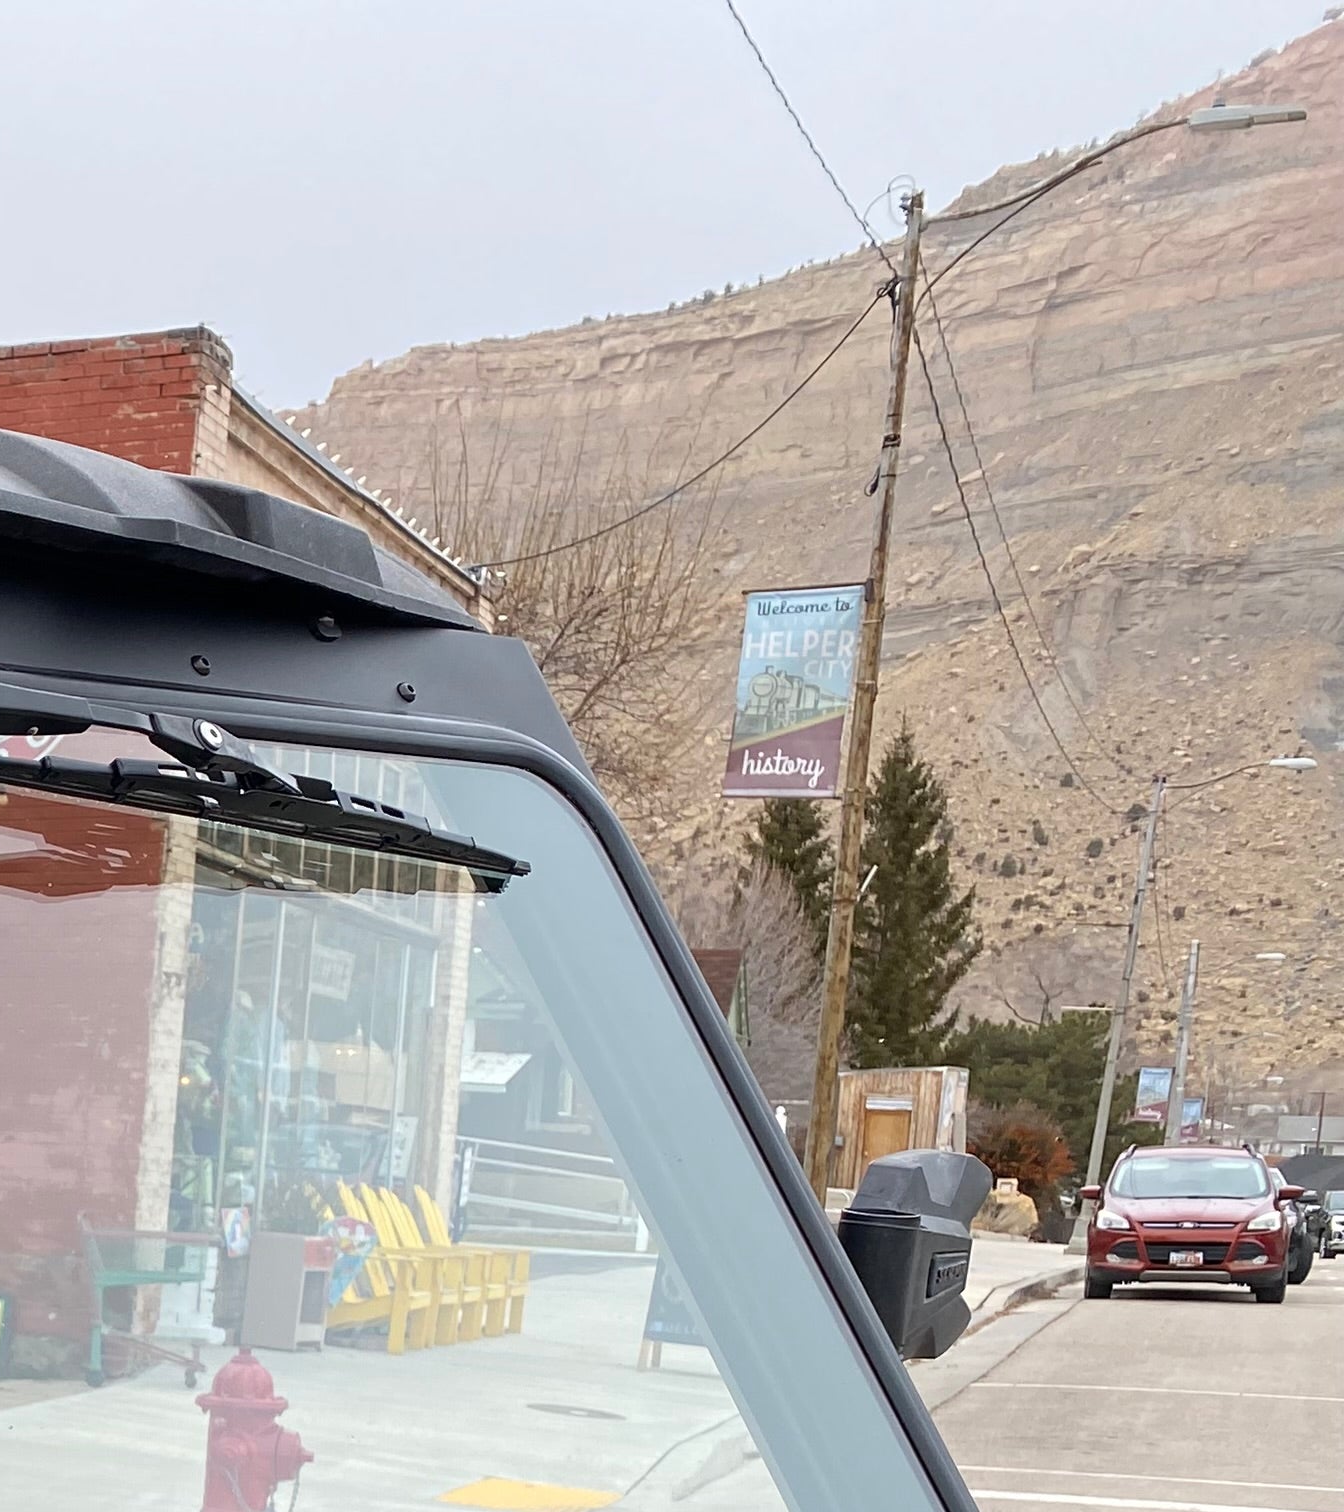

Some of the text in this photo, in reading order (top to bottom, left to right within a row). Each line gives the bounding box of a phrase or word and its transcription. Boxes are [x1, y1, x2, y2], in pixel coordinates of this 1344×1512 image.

[757, 597, 854, 617] Welcome to
[744, 629, 856, 659] HELPER
[804, 659, 853, 679] CITY
[742, 749, 825, 788] history
